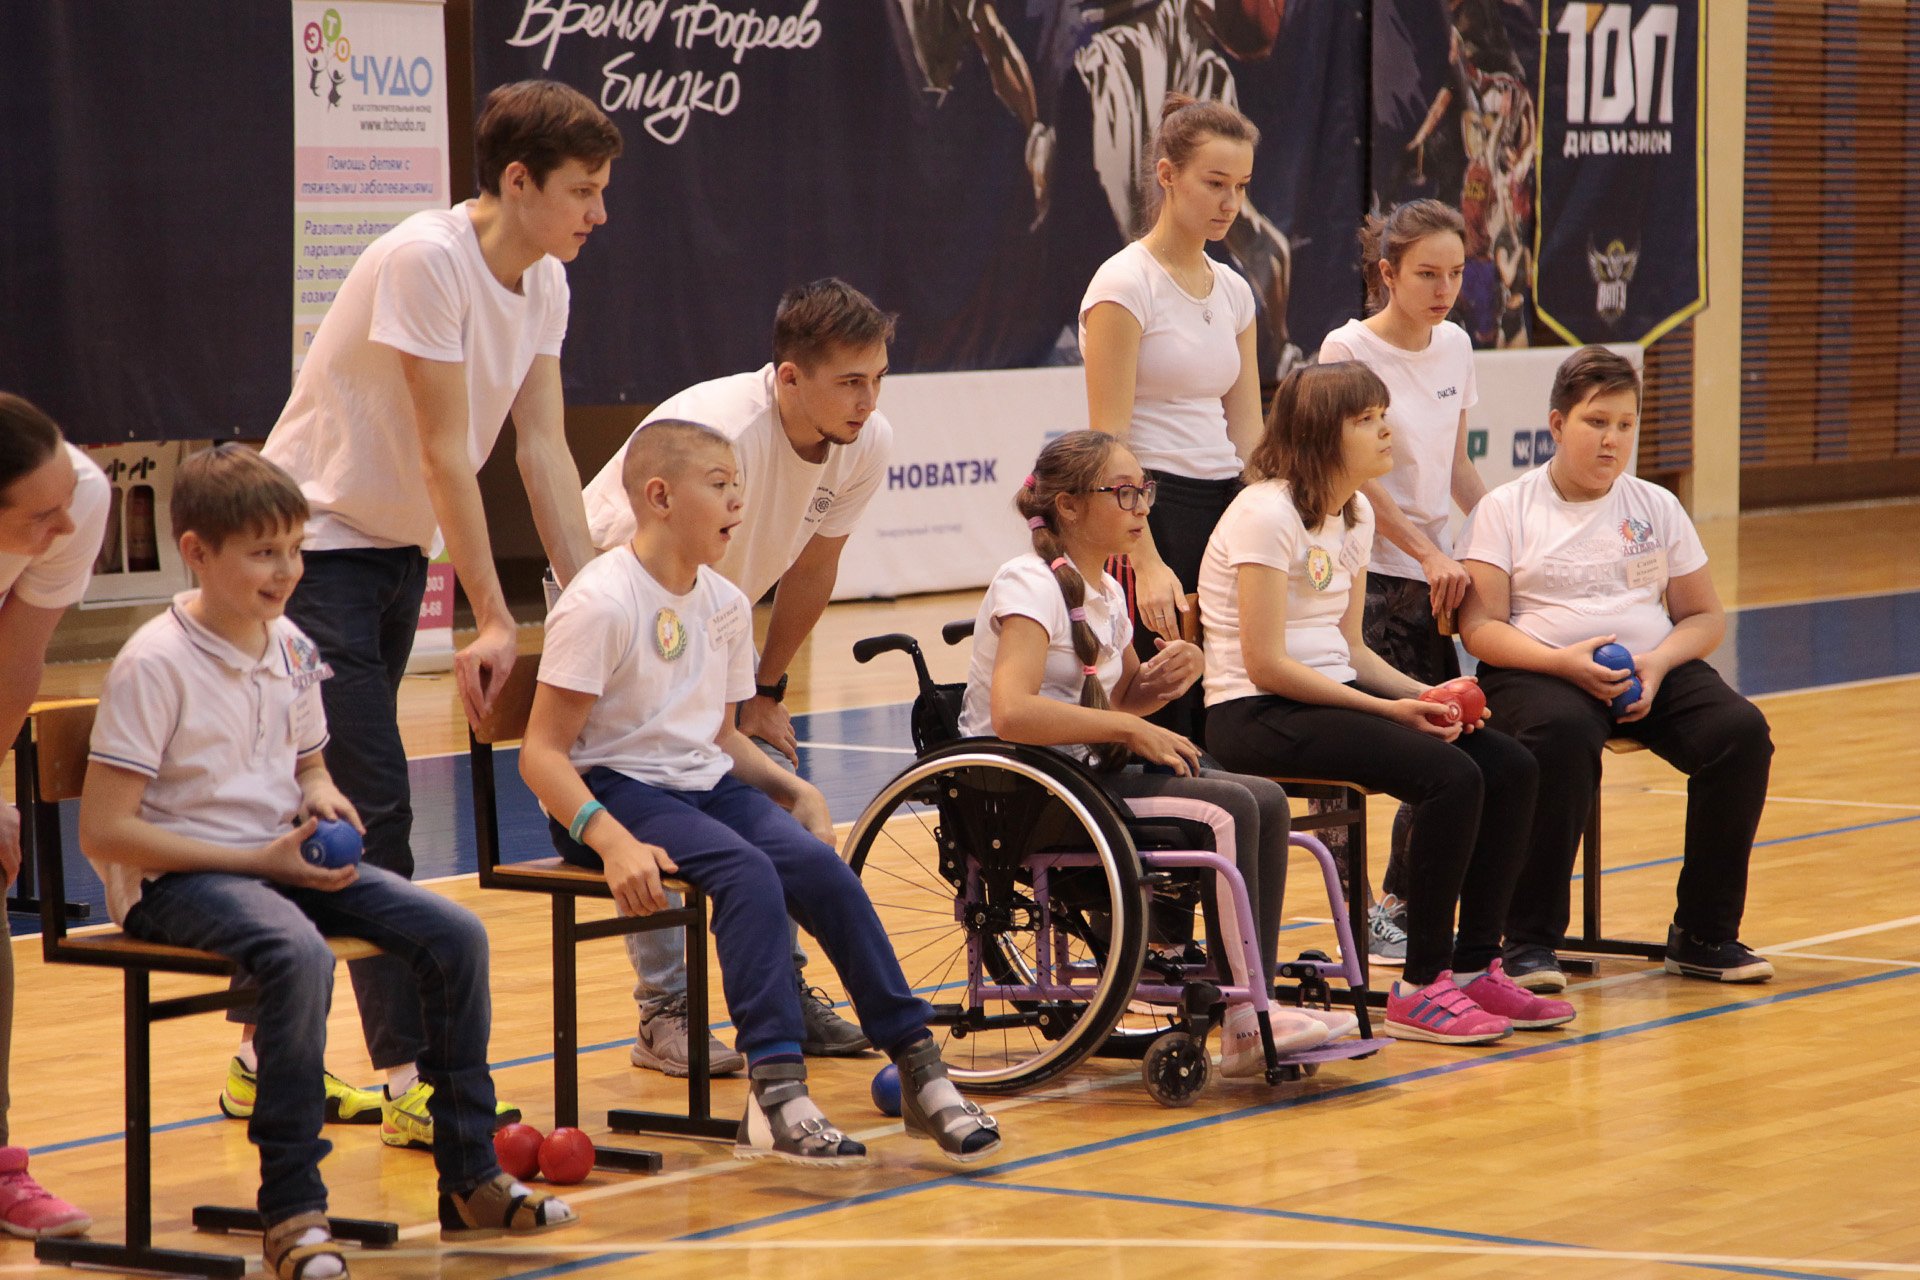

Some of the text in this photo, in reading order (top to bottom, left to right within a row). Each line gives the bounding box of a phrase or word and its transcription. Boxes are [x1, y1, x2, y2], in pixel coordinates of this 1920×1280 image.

[351, 55, 433, 97] ЧУДО
[601, 52, 740, 145] близко
[1562, 129, 1672, 158] ДИВИЗИОН
[888, 459, 997, 490] НОВАТЭК
